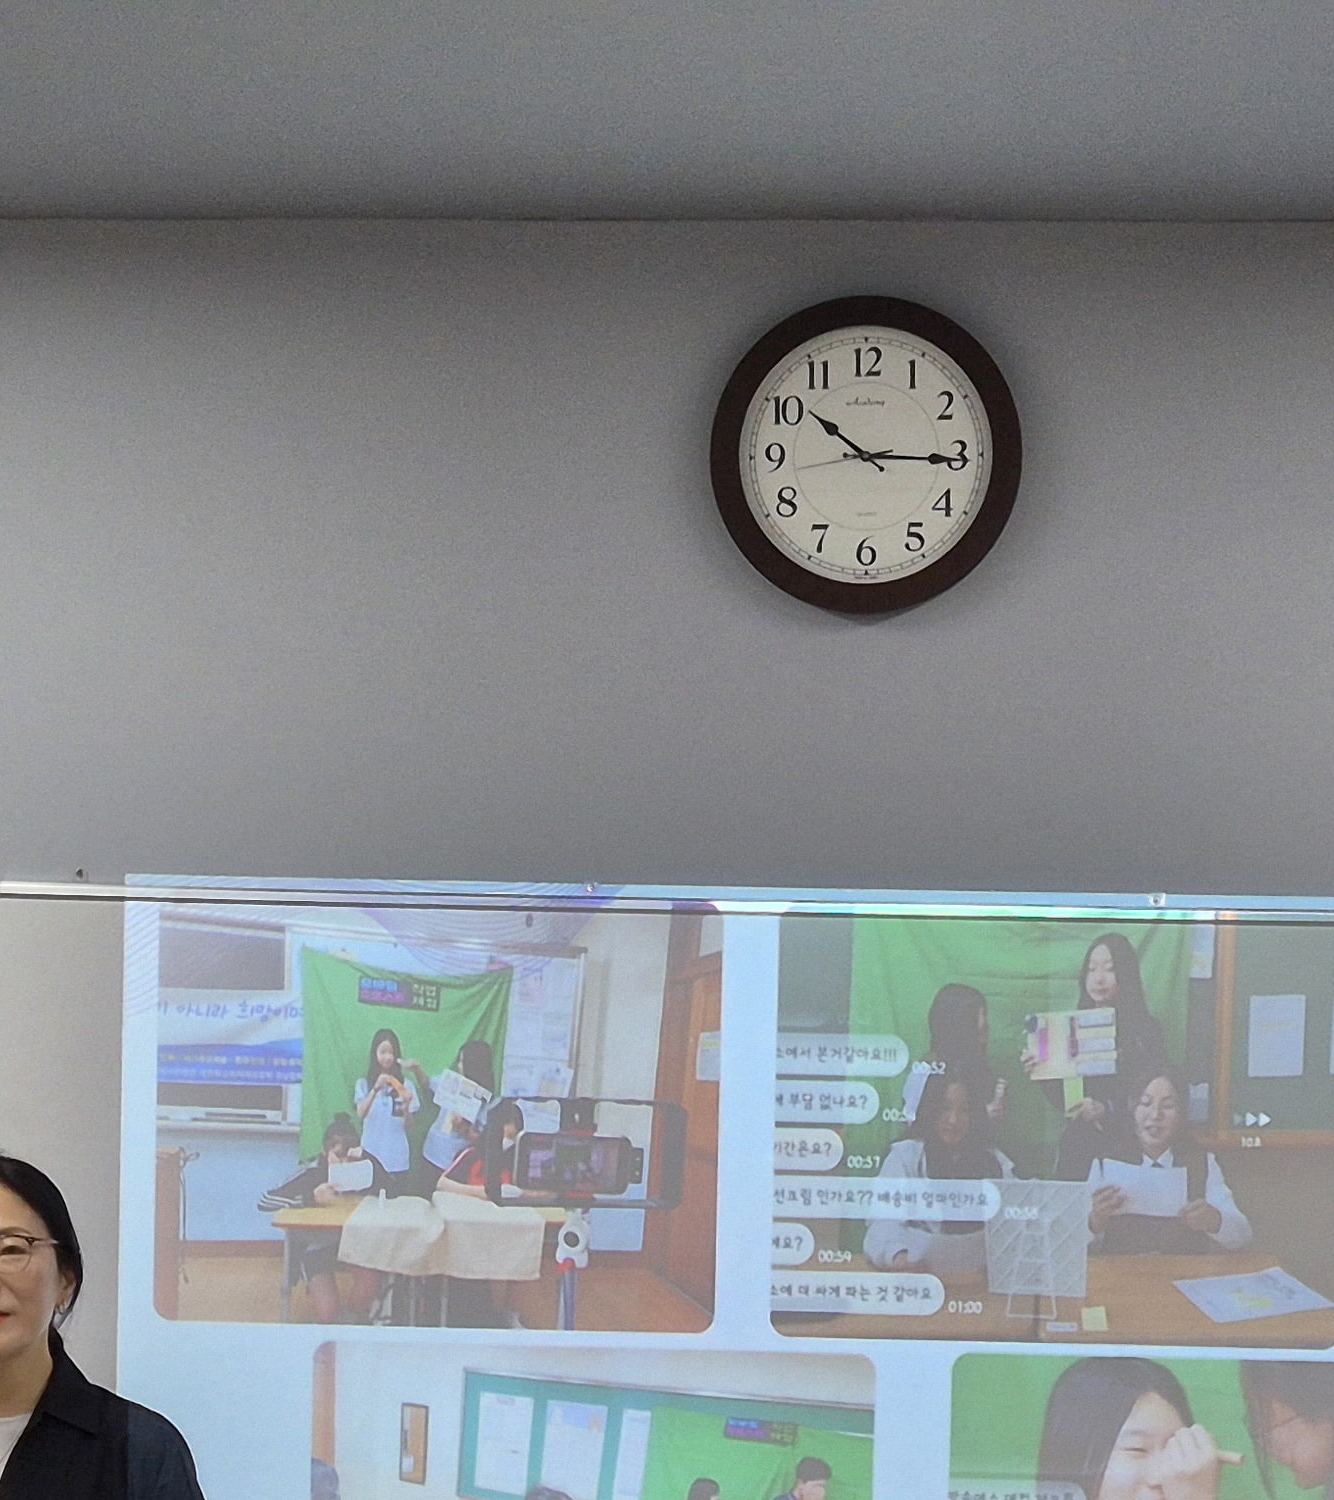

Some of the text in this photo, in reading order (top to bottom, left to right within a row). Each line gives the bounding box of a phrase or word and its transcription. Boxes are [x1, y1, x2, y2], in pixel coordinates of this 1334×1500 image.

[807, 360, 829, 390] 11
[853, 346, 883, 377] 12
[908, 359, 917, 389] 1
[773, 395, 804, 426] 10
[936, 390, 954, 420] 2
[765, 442, 786, 473] 9
[946, 439, 968, 471] 3
[776, 486, 798, 517] 8
[931, 487, 953, 517] 4
[810, 523, 829, 553] 7
[855, 535, 877, 567] 6
[904, 521, 926, 552] 5
[817, 1189, 874, 1205] 인가요??
[893, 1286, 933, 1304] 같아요
[948, 1301, 983, 1315] 01:00
